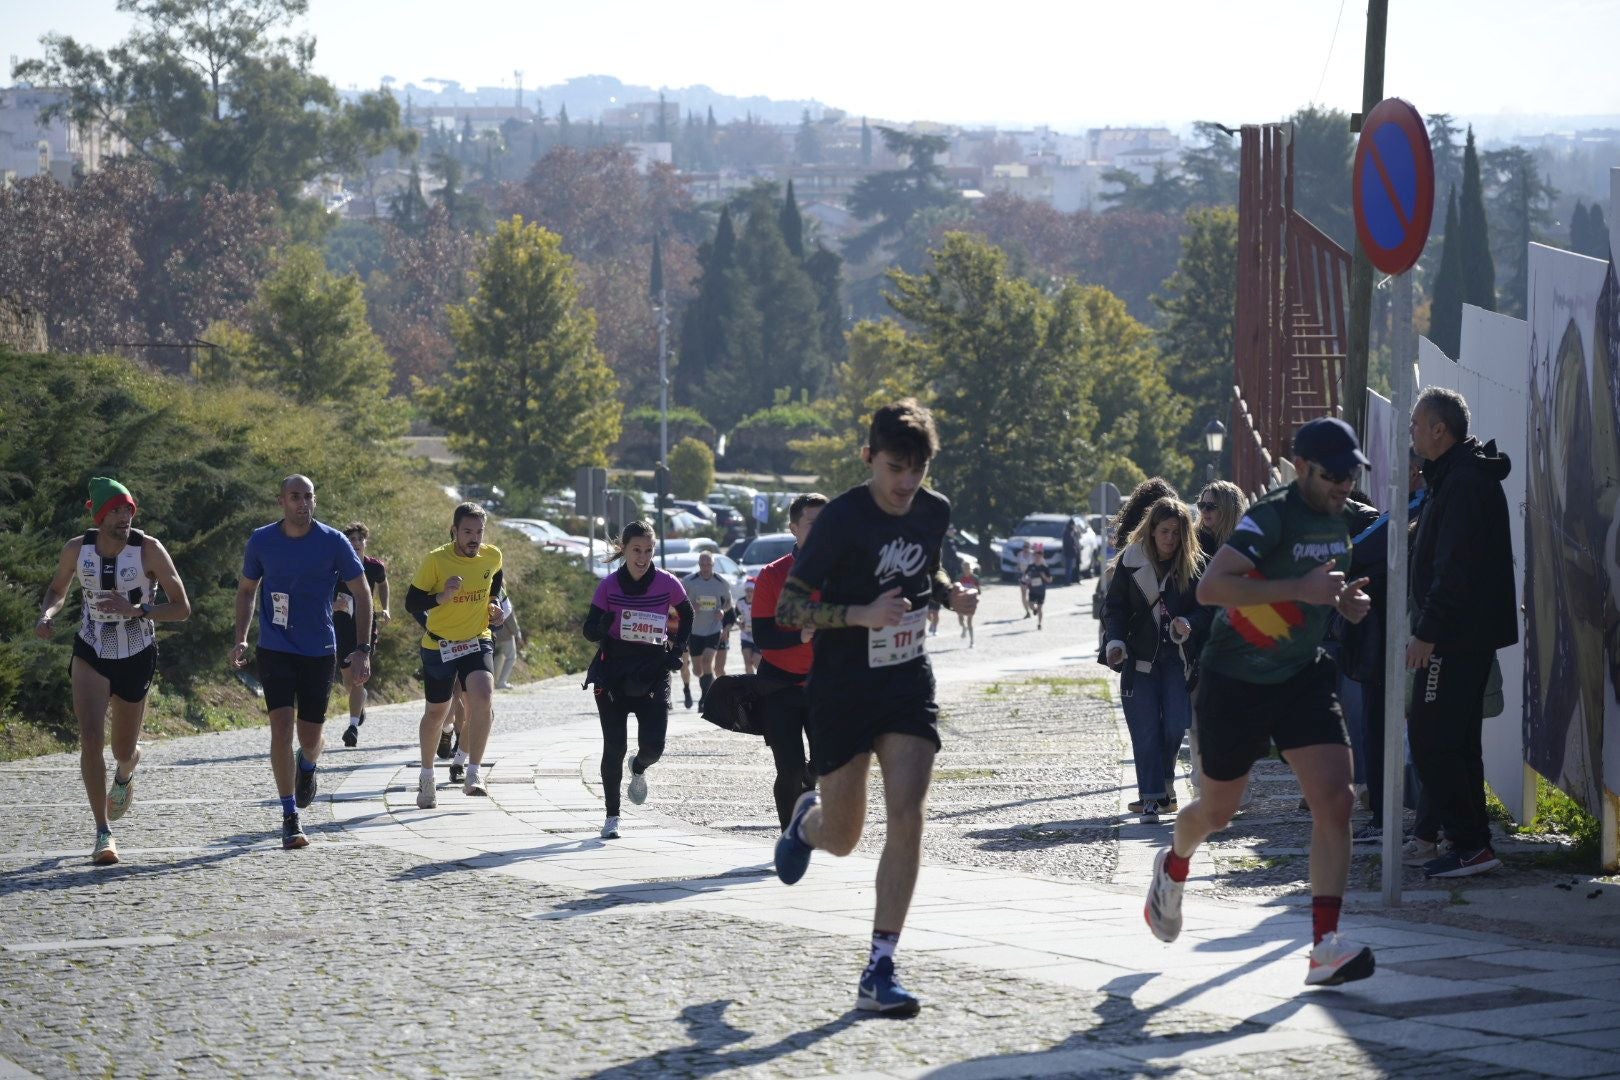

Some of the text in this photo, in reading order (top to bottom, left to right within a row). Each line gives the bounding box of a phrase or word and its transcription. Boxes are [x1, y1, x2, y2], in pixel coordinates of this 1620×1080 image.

[756, 497, 766, 518] P
[632, 622, 653, 634] 2401
[893, 629, 912, 648] 171
[1424, 654, 1443, 703] Joma
